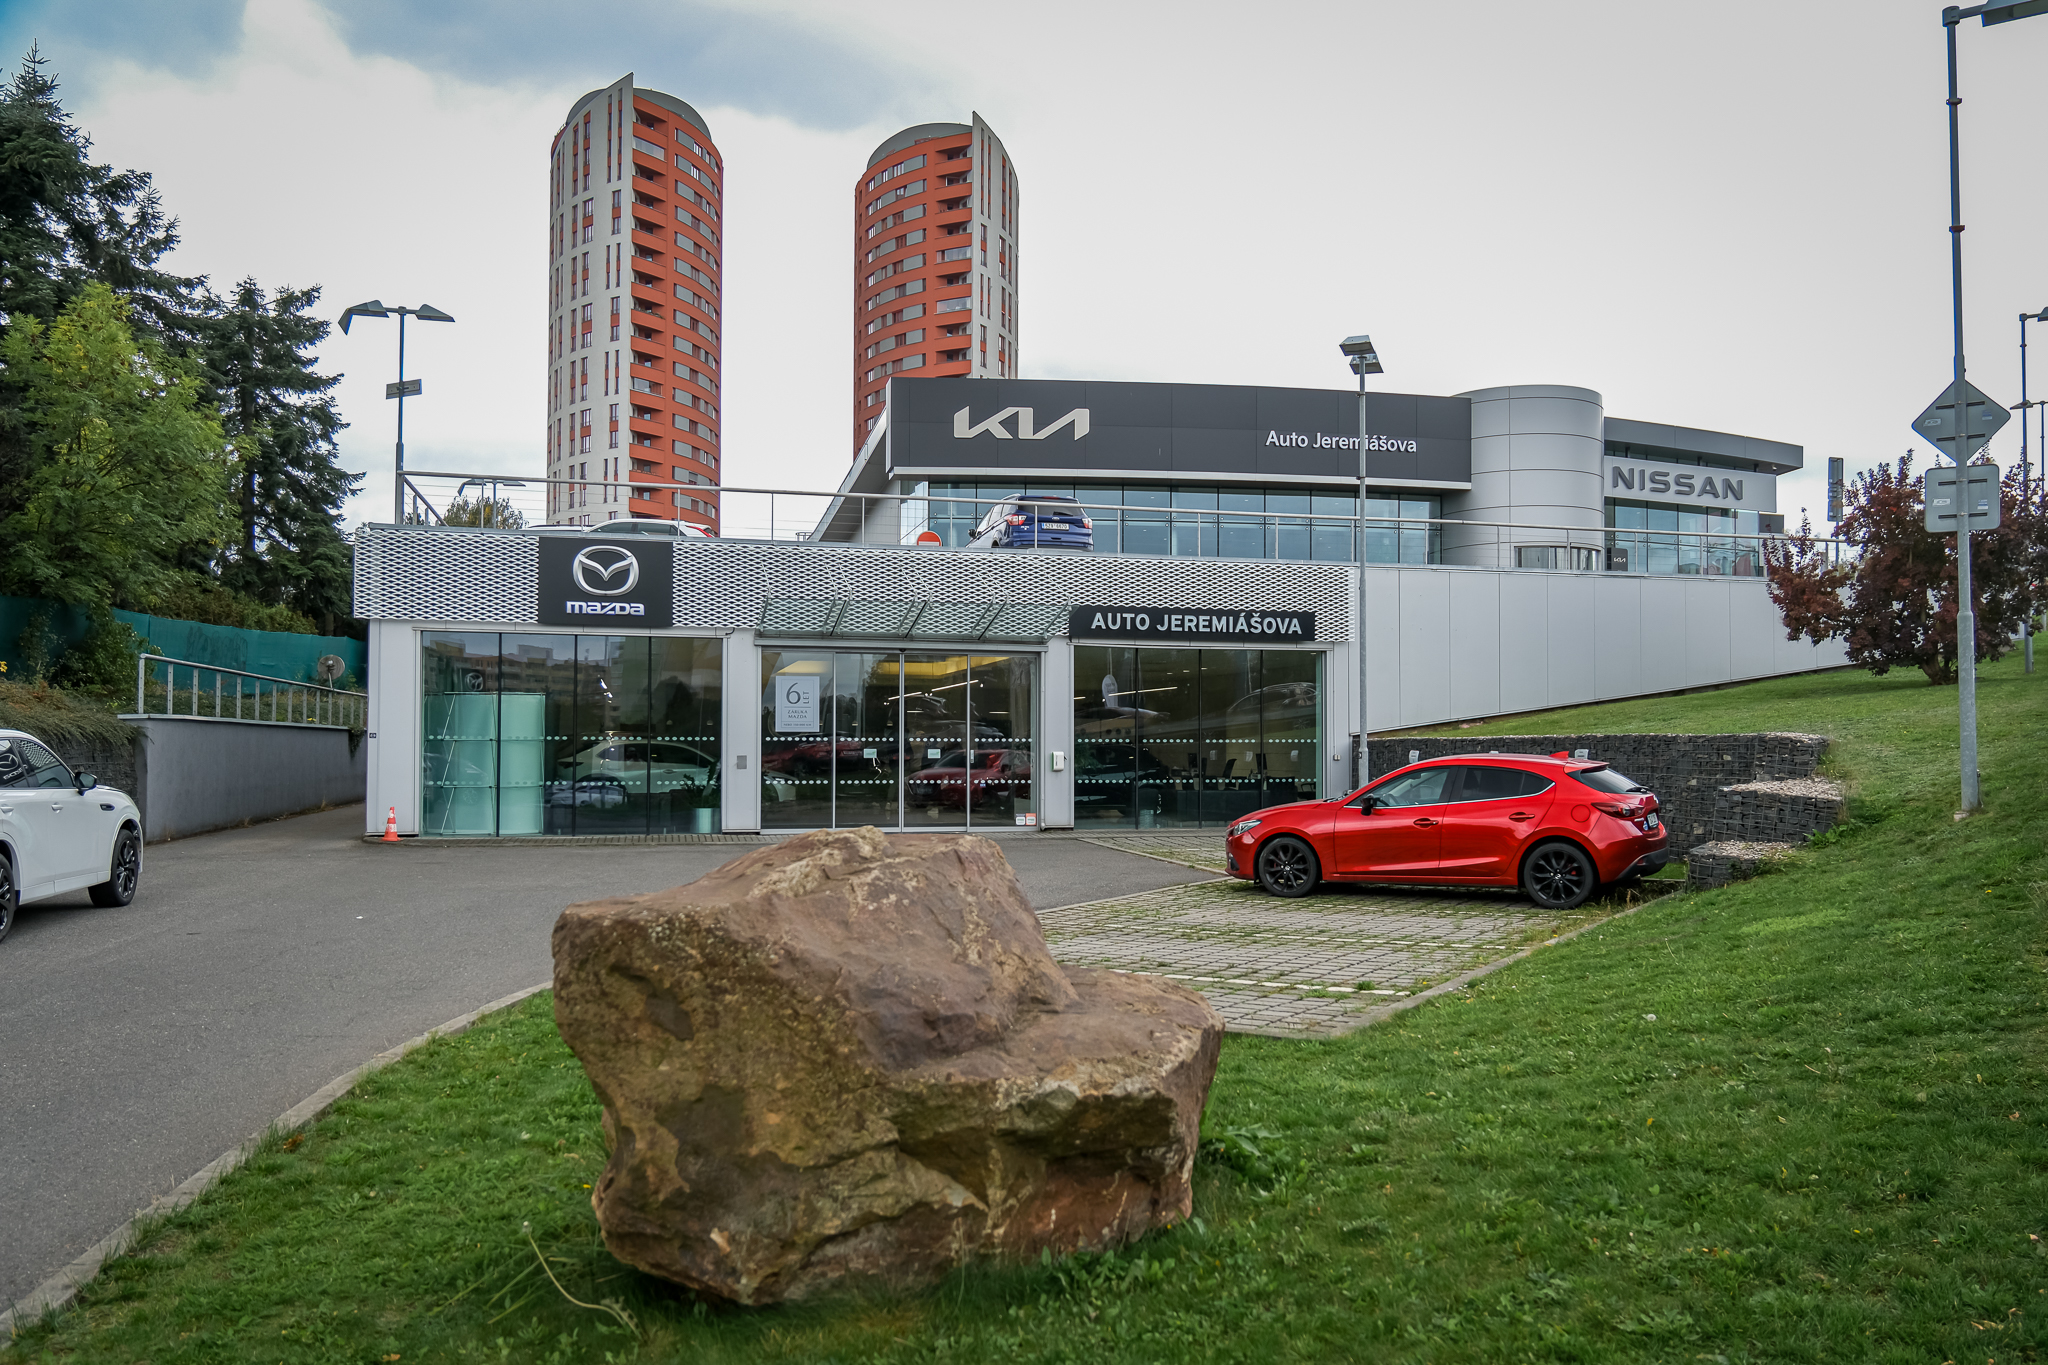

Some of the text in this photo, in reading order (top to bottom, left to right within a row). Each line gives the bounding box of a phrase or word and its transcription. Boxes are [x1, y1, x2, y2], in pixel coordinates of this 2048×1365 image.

[953, 405, 1090, 441] KIA
[1265, 430, 1417, 453] Auto Jeremiášova
[1612, 465, 1744, 501] NISSAN
[1091, 612, 1302, 635] AUTO JEREMIÁŠOVA
[786, 682, 801, 705] 6
